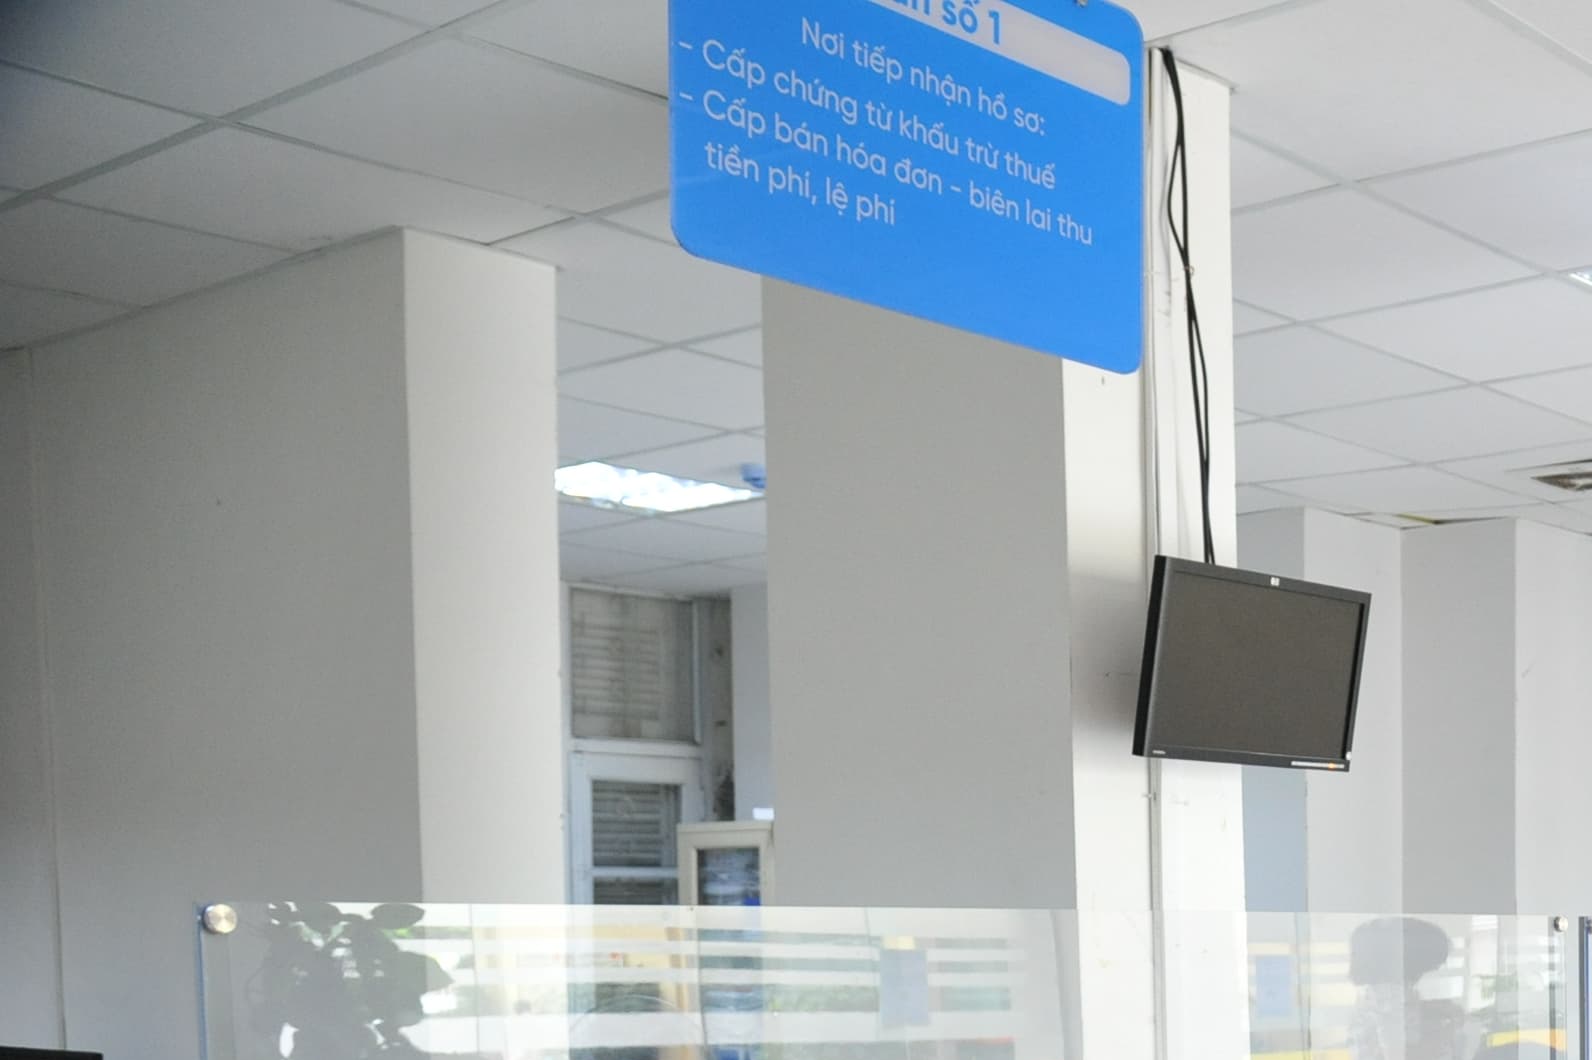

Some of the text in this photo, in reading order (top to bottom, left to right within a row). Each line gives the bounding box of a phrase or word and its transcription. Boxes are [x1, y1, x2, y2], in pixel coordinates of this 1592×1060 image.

[802, 16, 1045, 137] Nơi tiếp nhận hồ sơ:
[988, 10, 1000, 45] 1
[702, 39, 766, 89] Cấp
[773, 69, 858, 125] chứng
[865, 100, 893, 132] từ
[899, 110, 959, 156] khấu
[965, 137, 999, 170] trừ
[1003, 151, 1056, 190] thuế
[702, 90, 766, 139] Cấp
[774, 112, 829, 157] bán
[836, 133, 887, 176] hóa
[894, 157, 942, 195] đơn
[969, 180, 1020, 221] biên
[1026, 198, 1051, 232] lai
[1057, 213, 1093, 246] thu
[704, 141, 760, 182] tiền
[825, 176, 848, 216] lệ
